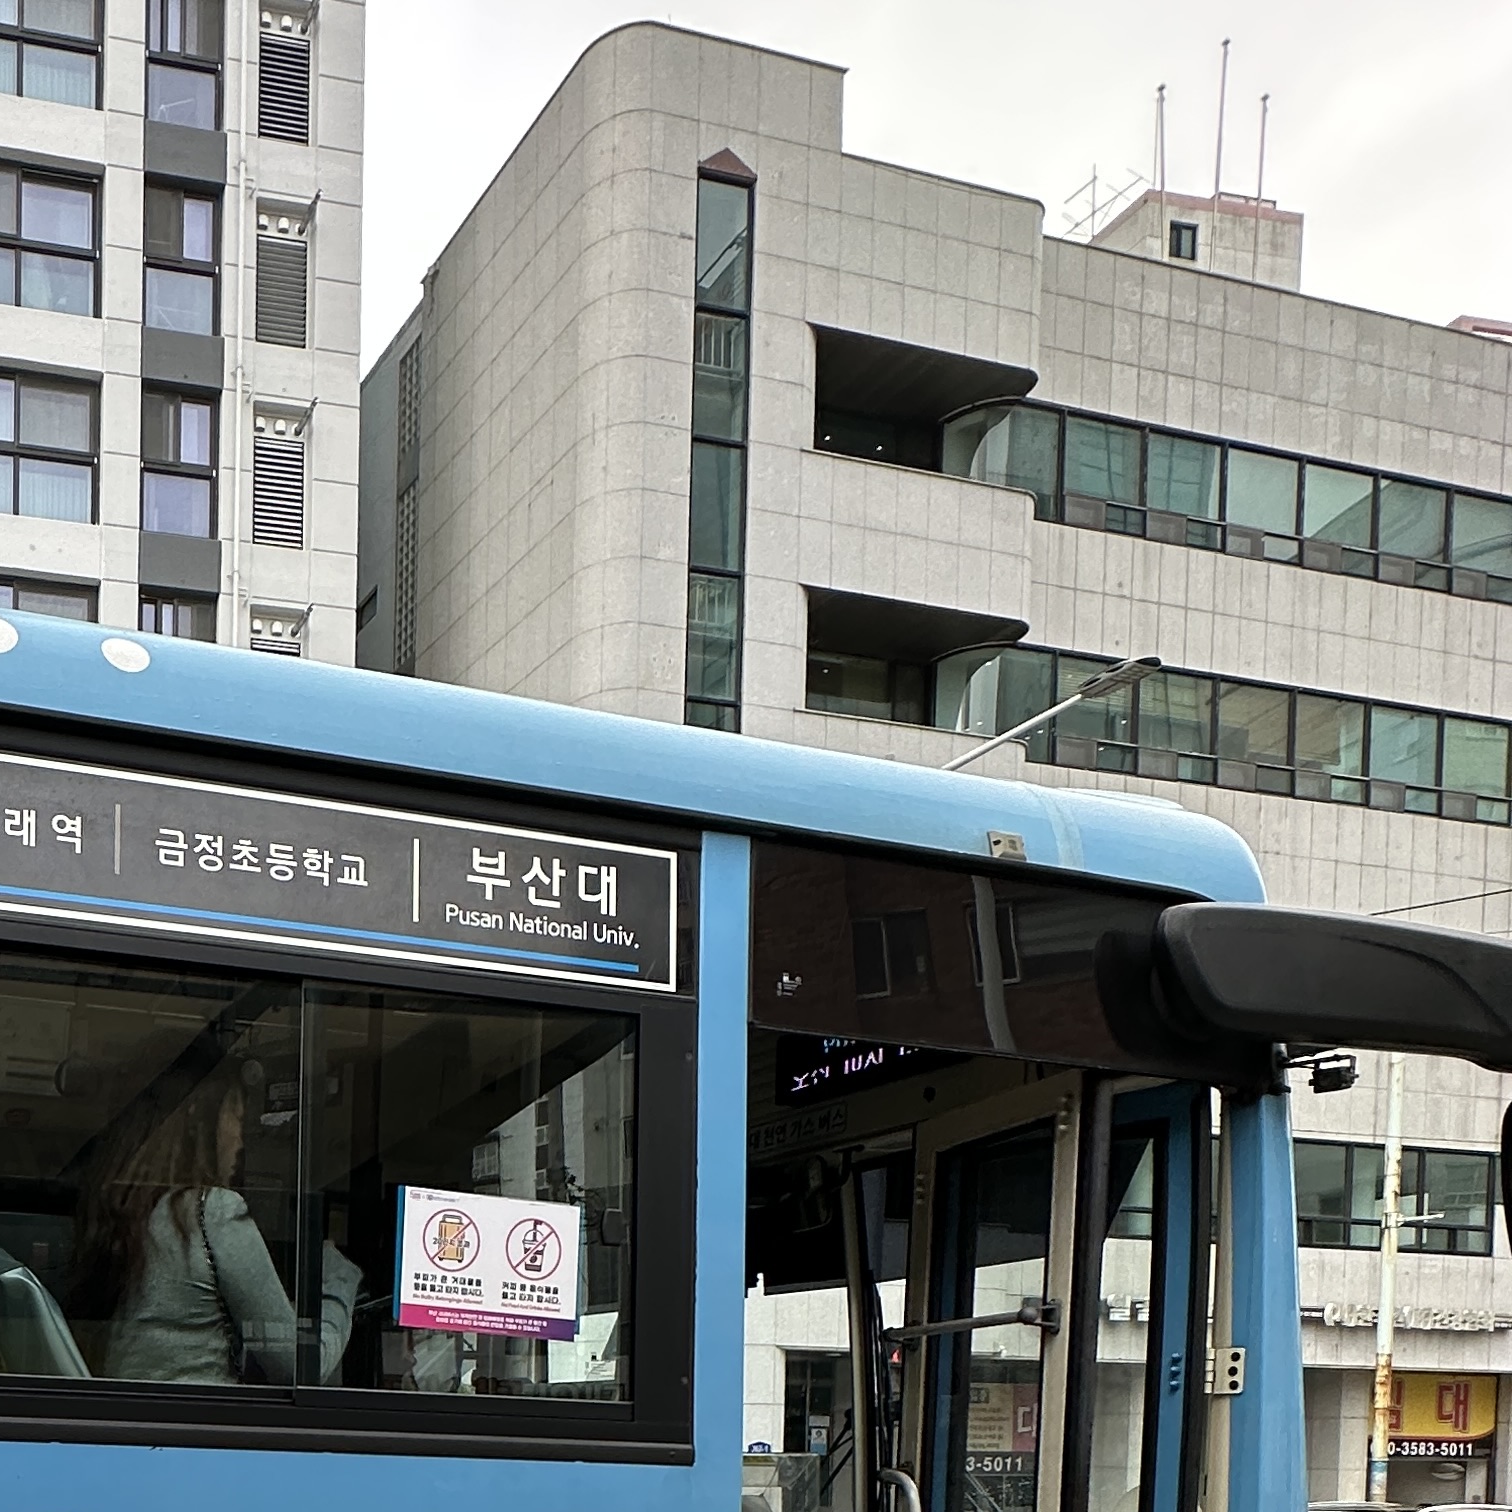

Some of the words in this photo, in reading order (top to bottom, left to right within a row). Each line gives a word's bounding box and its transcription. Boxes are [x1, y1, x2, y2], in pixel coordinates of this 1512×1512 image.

[153, 827, 370, 889] 금정초등학교
[465, 845, 619, 918] 부산대
[444, 902, 504, 931] Pusan
[508, 912, 588, 942] National
[592, 922, 640, 950] Univ.
[1370, 1441, 1474, 1457] 0-3583-5011
